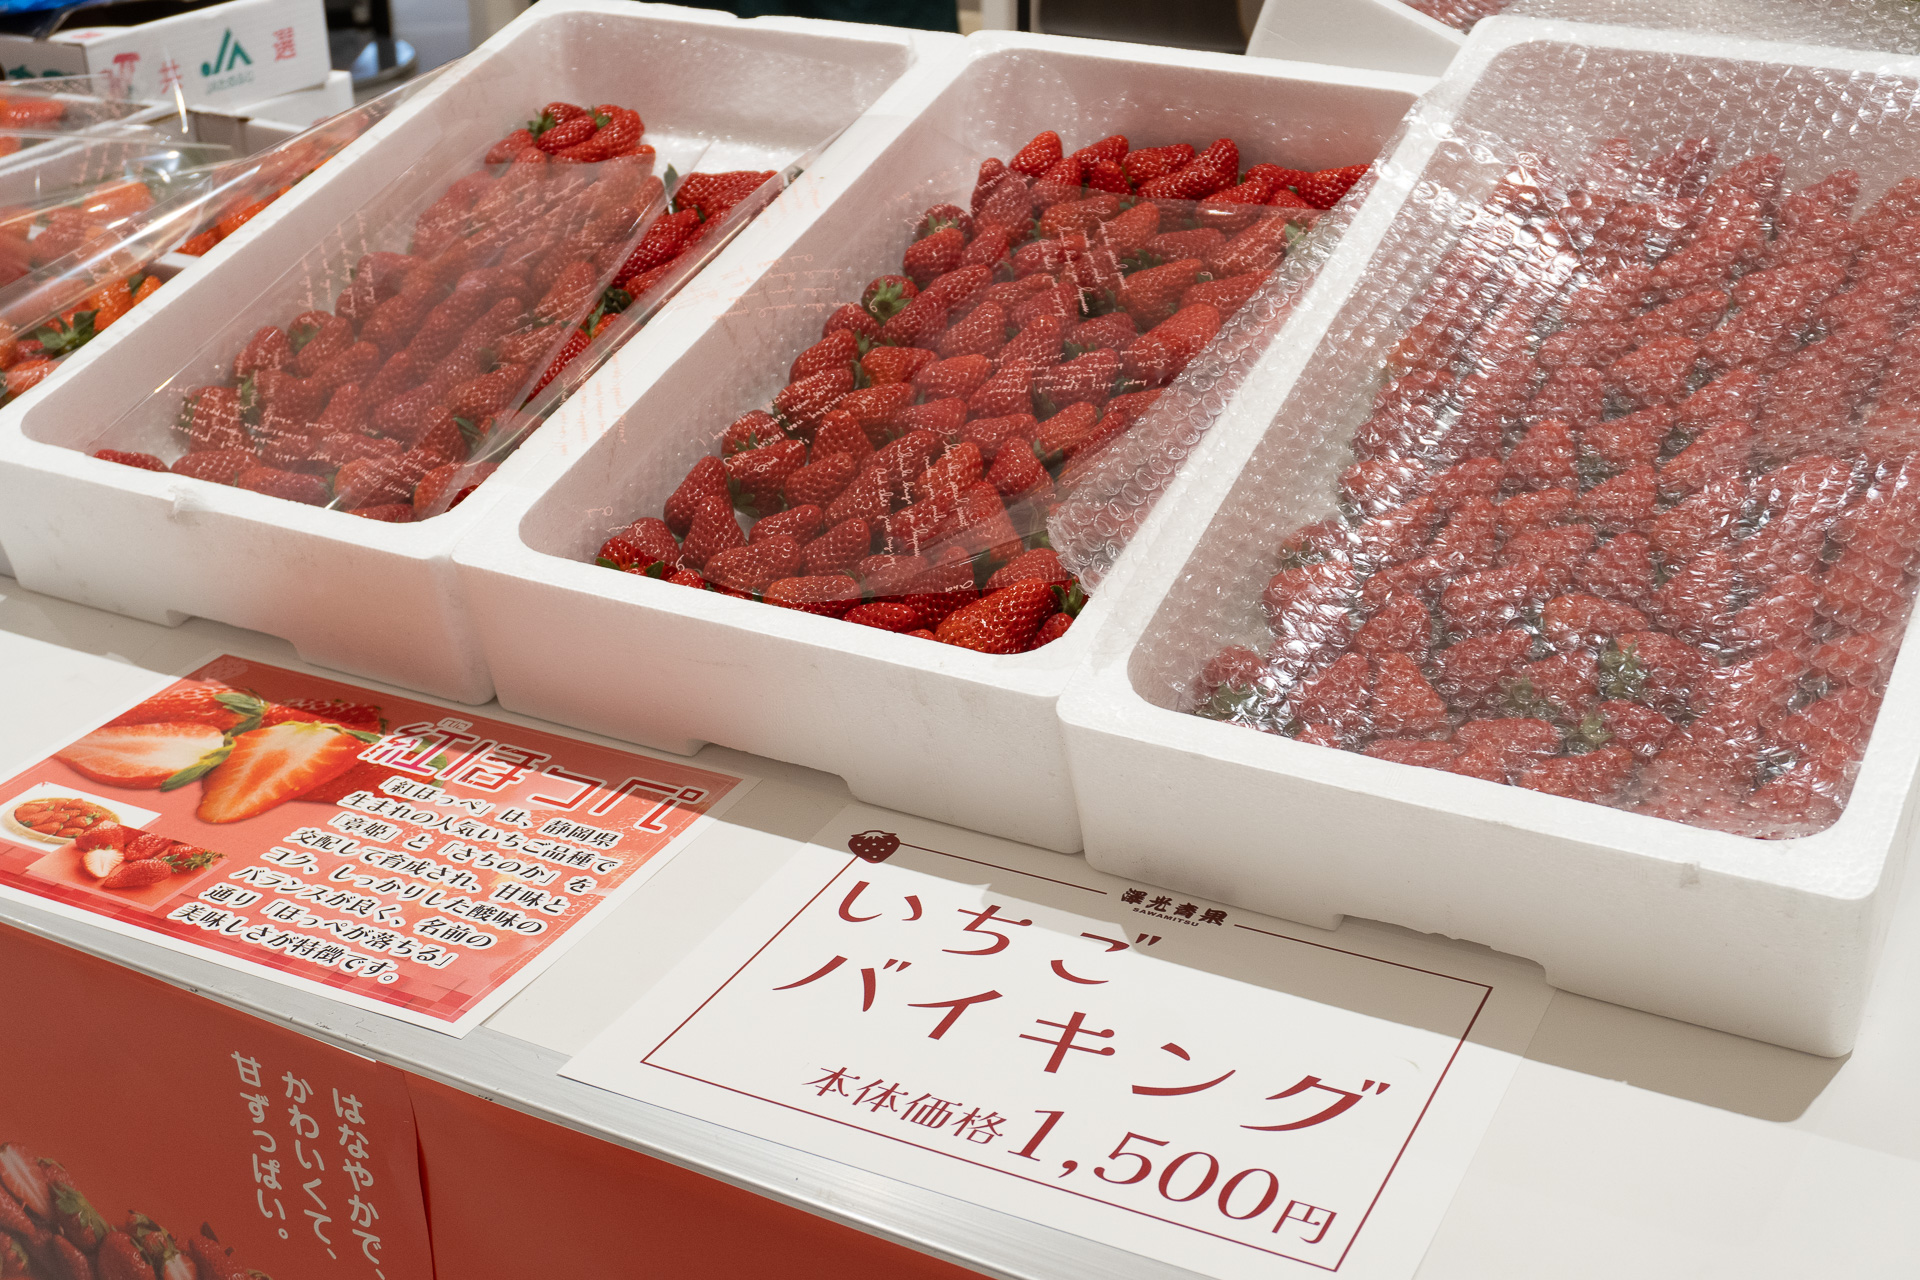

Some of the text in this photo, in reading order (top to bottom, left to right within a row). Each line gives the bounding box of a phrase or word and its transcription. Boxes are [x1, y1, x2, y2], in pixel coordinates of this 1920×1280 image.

[289, 829, 566, 914] 交配して育成され、甘味と
[340, 792, 618, 873] 生まれの人気いちご品種で
[203, 885, 453, 967] 通り「ほっぺが落ちる」
[233, 868, 492, 948] バランスが良く、名前の
[265, 848, 543, 934] コク、しっかりした酸味の
[838, 880, 1162, 985] いちご
[1132, 907, 1199, 927] SAWAMITSU
[172, 904, 394, 982] 美味しさが特徴です。
[772, 955, 1391, 1132] バイキング
[231, 1051, 289, 1240] 甘ずっぱい。
[281, 1071, 337, 1260] かわいくて、
[333, 1087, 386, 1280] はなやかで、
